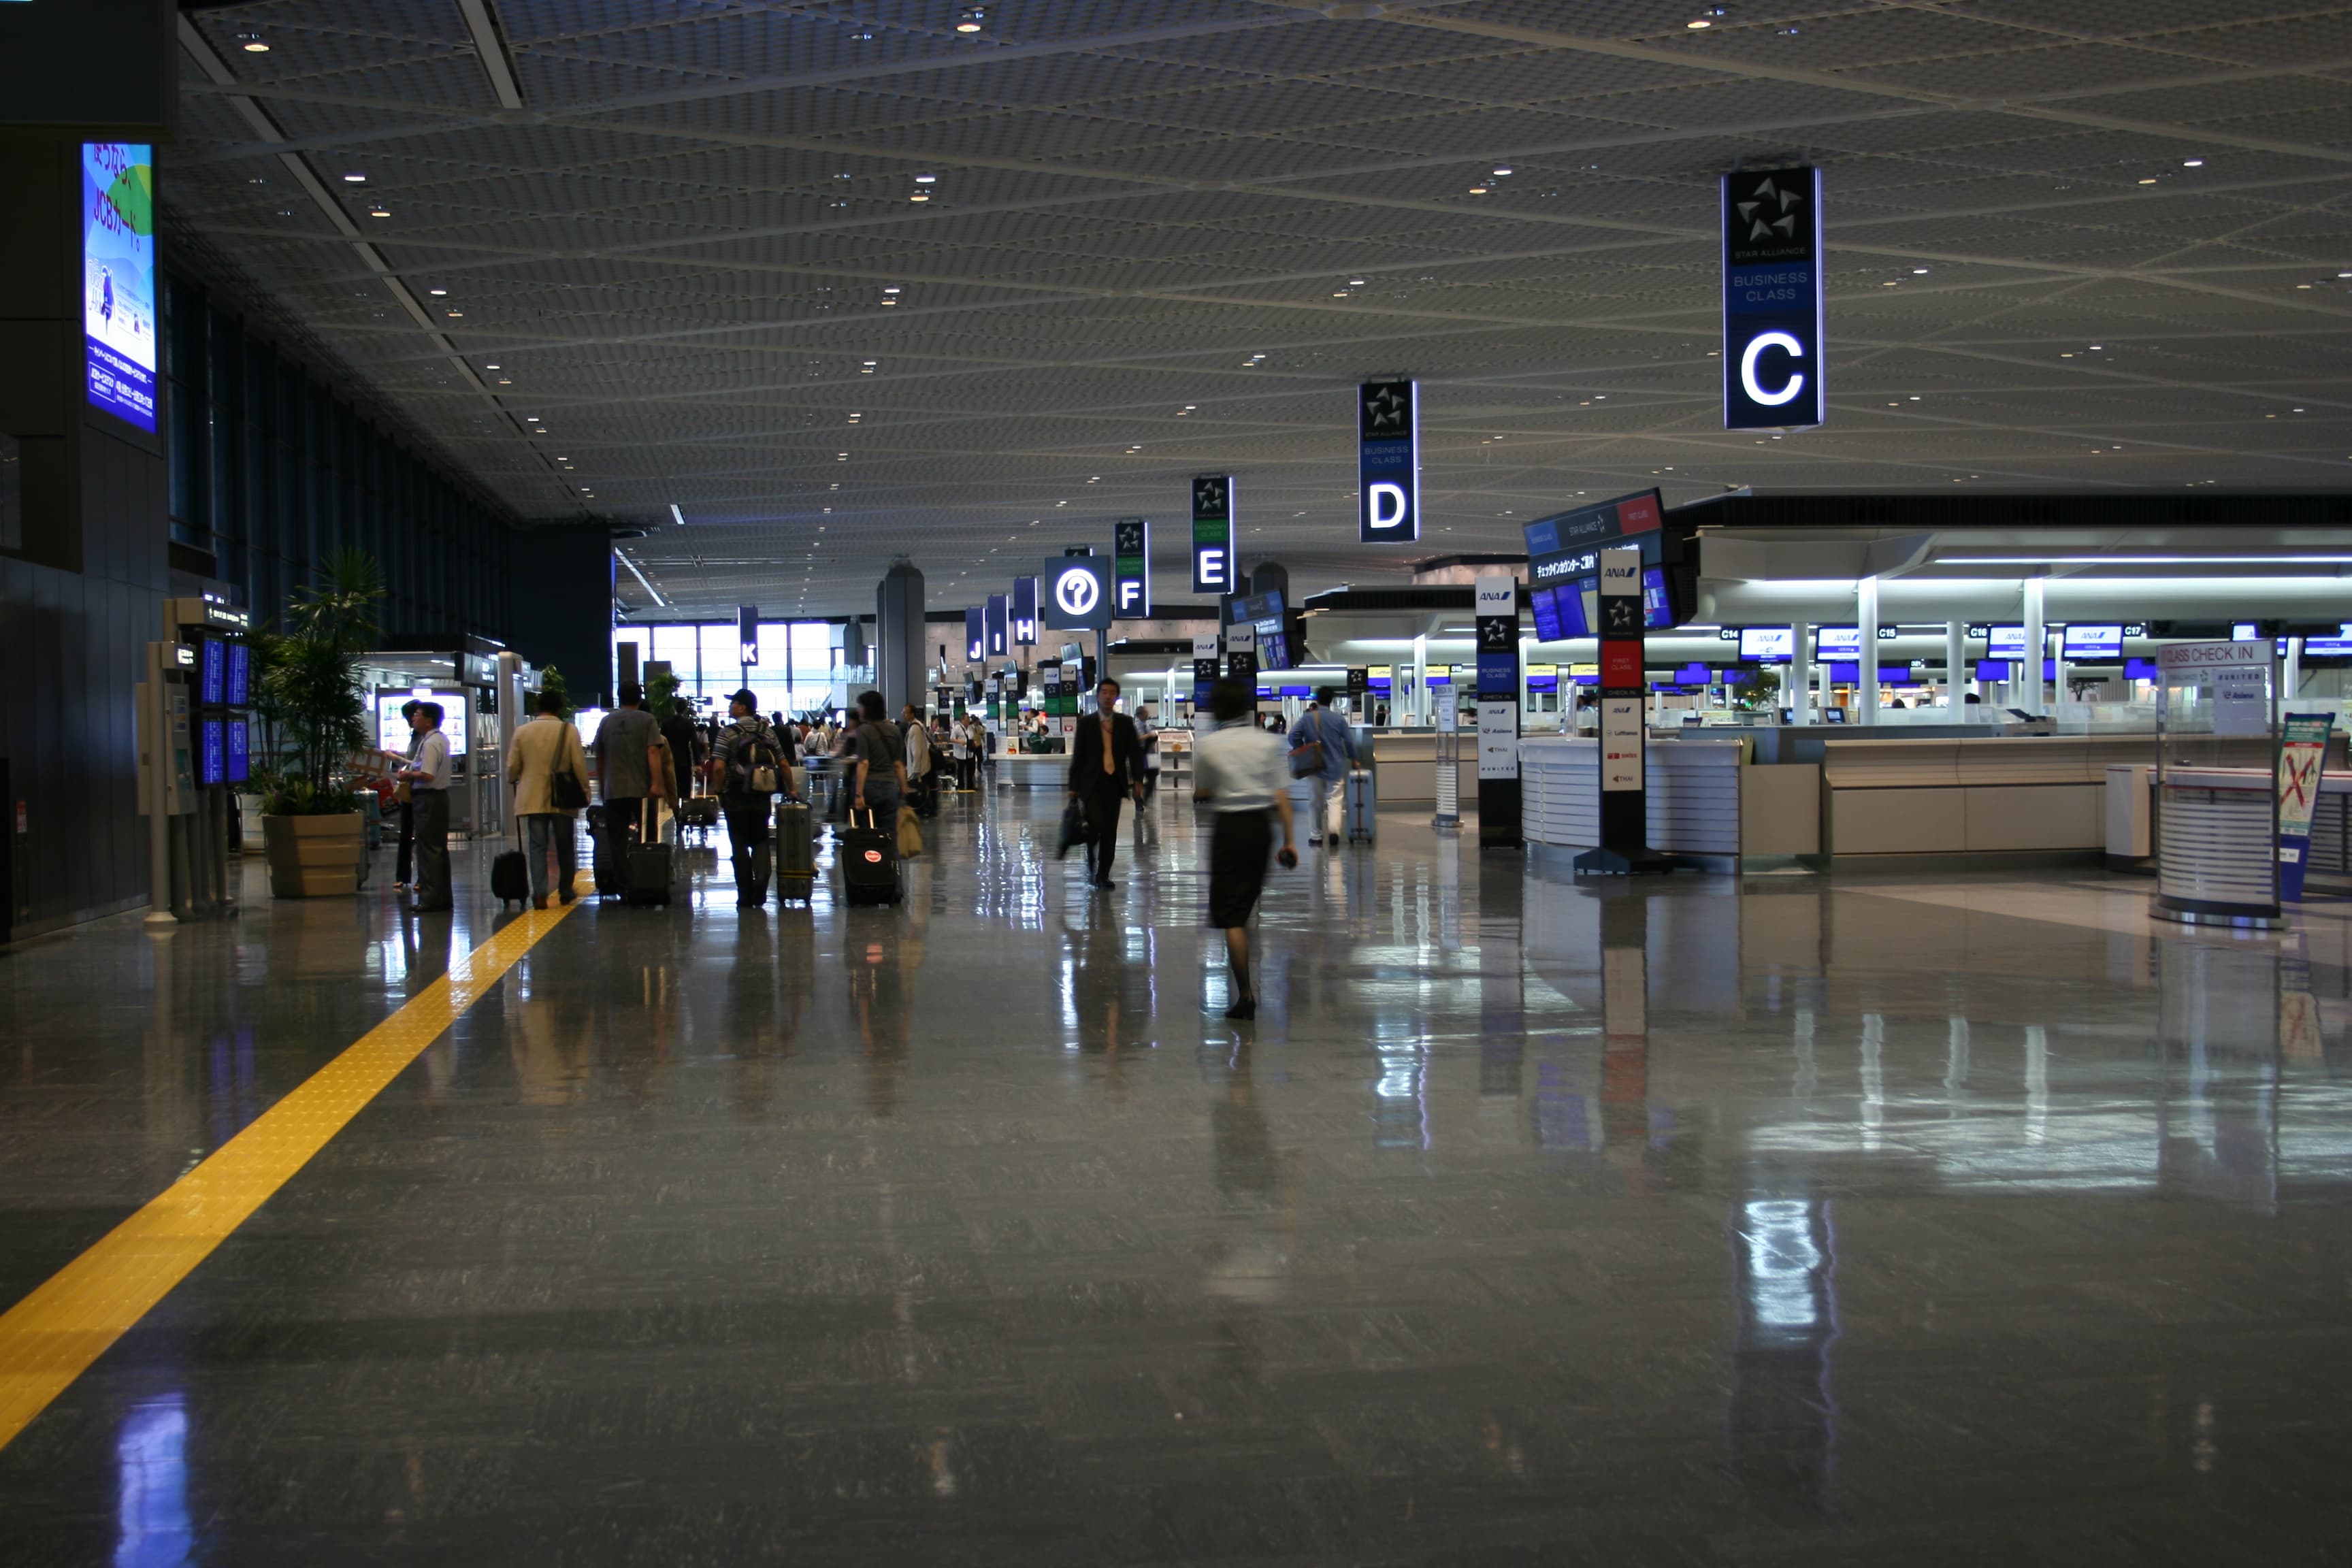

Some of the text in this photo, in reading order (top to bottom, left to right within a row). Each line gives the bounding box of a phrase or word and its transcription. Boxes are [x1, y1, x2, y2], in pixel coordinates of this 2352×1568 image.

[1735, 246, 1806, 259] STAR ALLIANCE
[1734, 272, 1808, 287] BUSINESS
[1746, 289, 1796, 301] CLASS
[1741, 331, 1804, 406] C
[1365, 446, 1409, 455] BUSINESS
[1371, 455, 1402, 464] CLASS
[1369, 483, 1405, 529] D
[1200, 550, 1224, 584] E
[1604, 568, 1626, 577] ANA
[1122, 582, 1140, 610] F
[1480, 592, 1501, 600] ANA
[1017, 620, 1033, 641] H
[1721, 630, 1738, 638] C14
[1879, 629, 1895, 637] C15
[1970, 628, 1987, 637] C16
[2125, 627, 2141, 635] C17
[995, 633, 1000, 651] I
[742, 644, 756, 662] K
[970, 641, 981, 659] J
[2191, 647, 2233, 662] CHECK
[2238, 647, 2253, 659] IN
